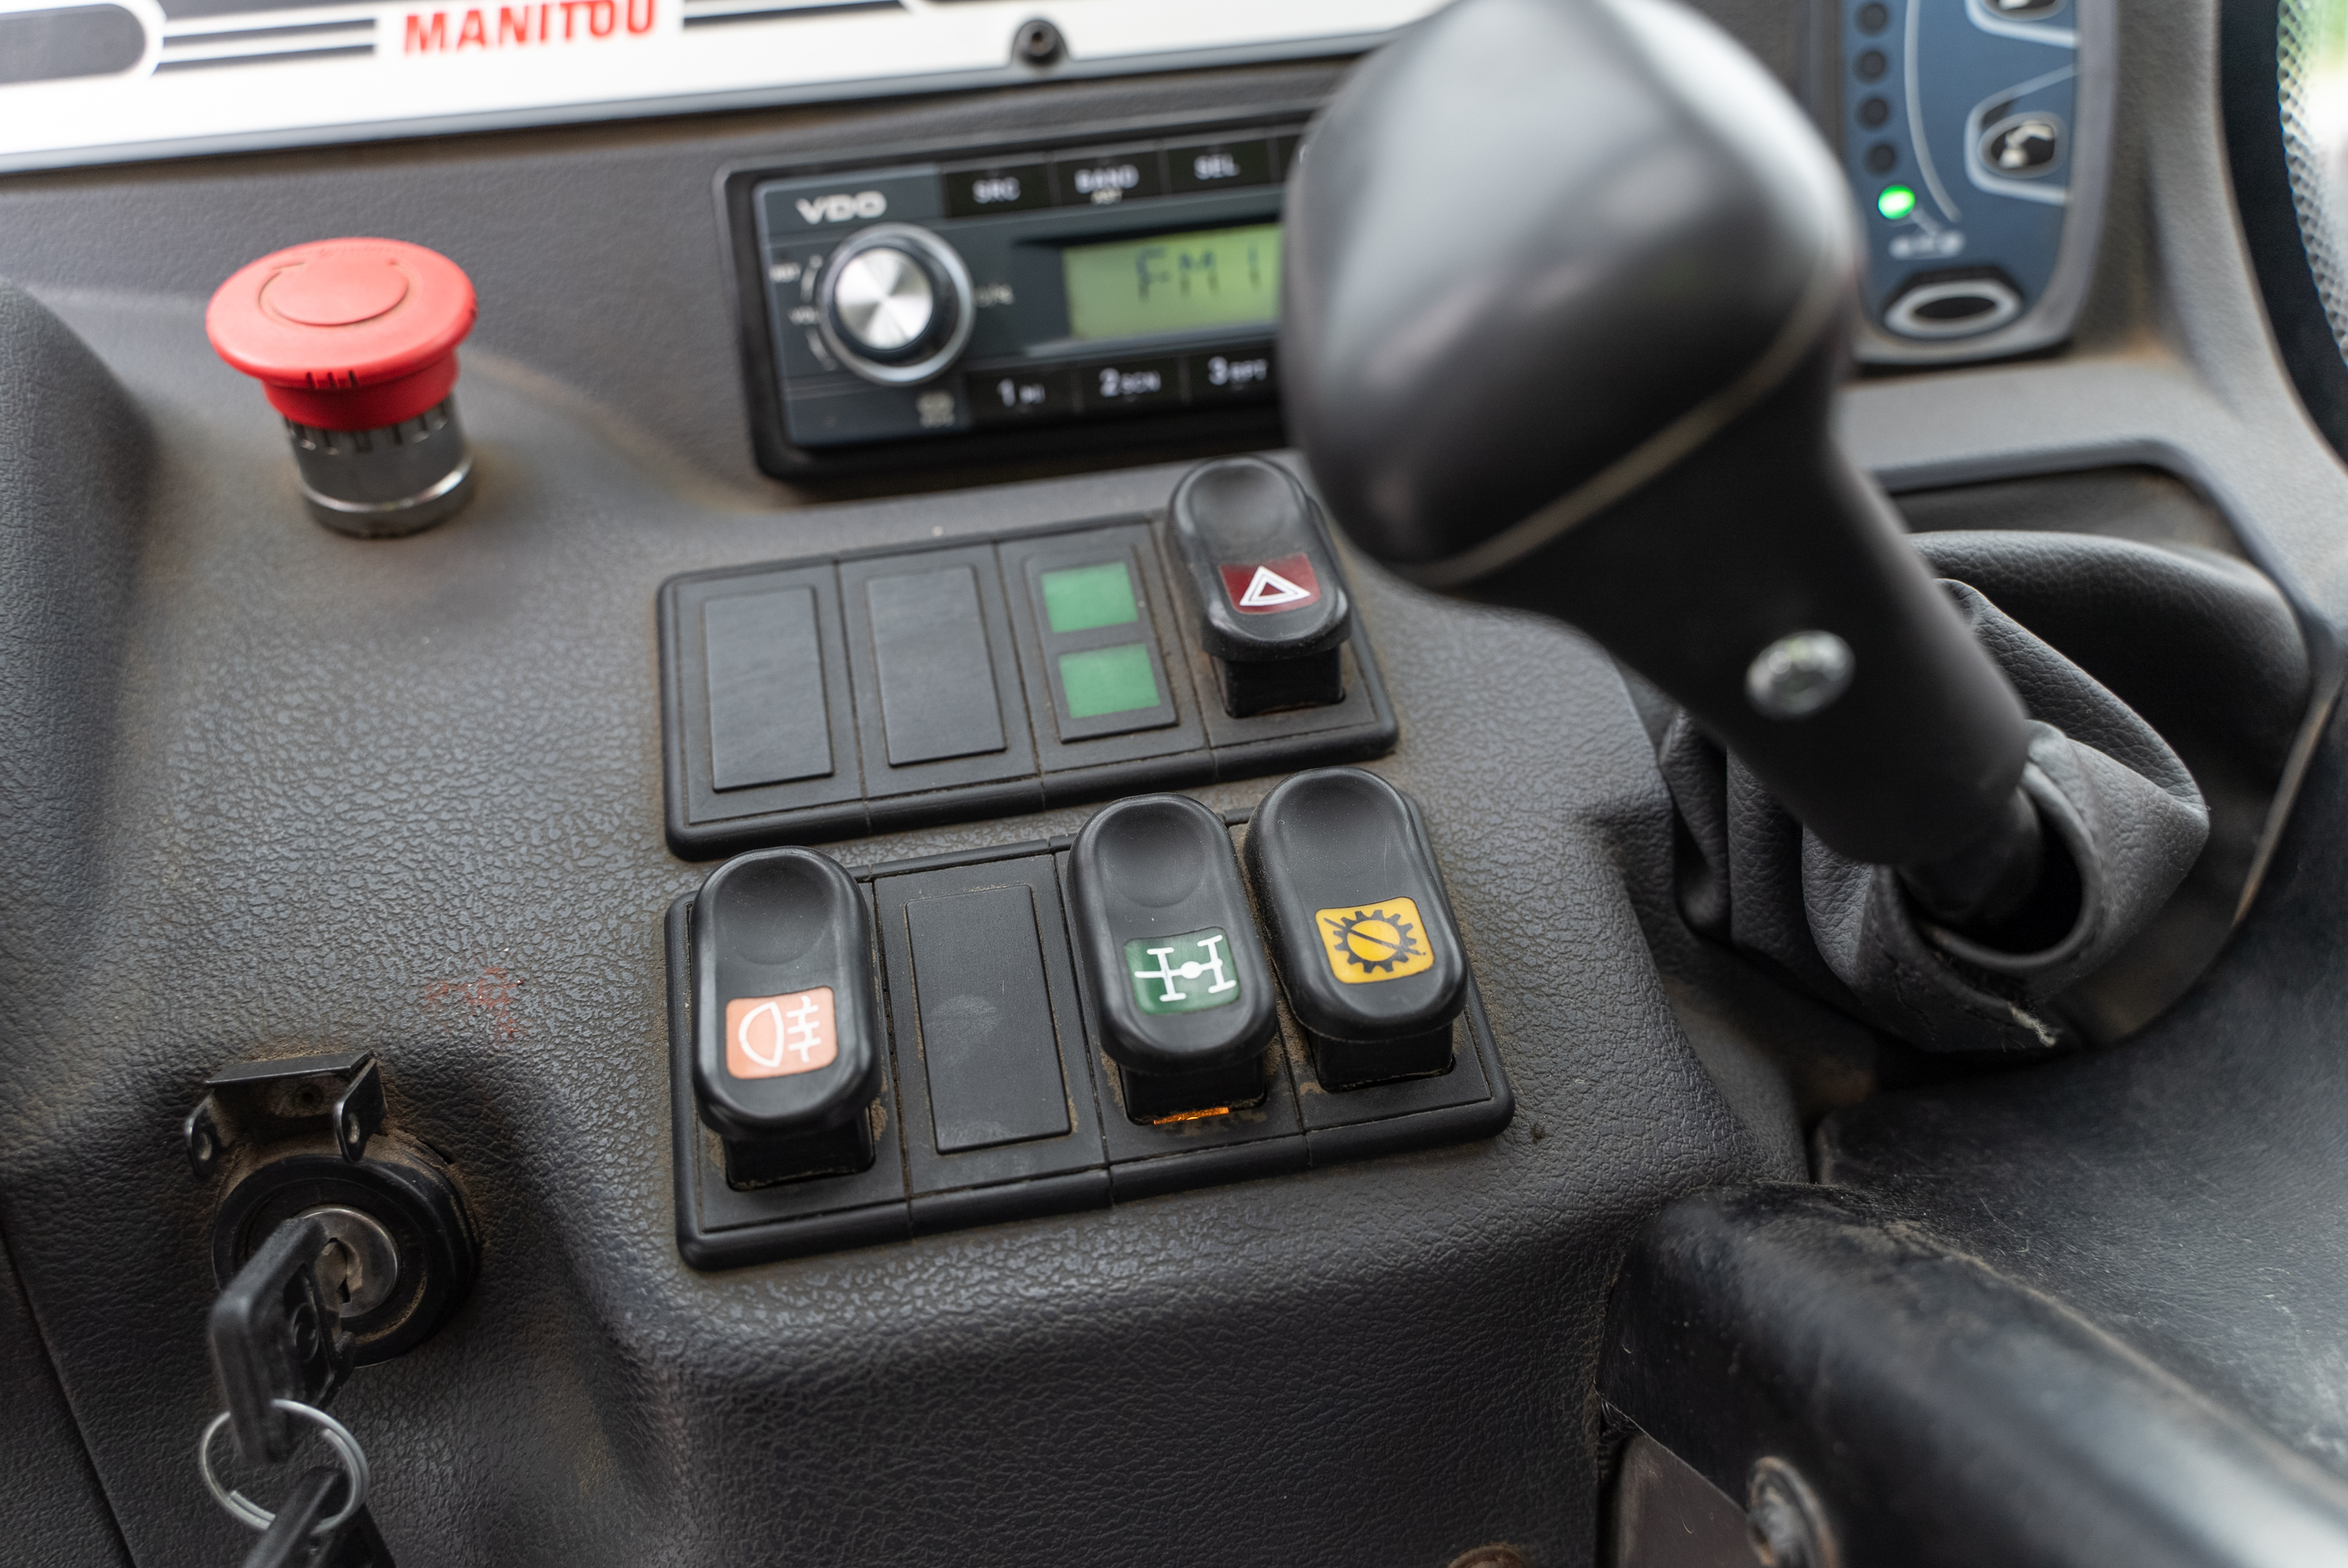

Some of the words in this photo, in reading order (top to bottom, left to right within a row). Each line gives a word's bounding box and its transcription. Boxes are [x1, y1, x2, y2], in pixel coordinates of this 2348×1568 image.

[404, 0, 655, 54] MANITOU
[1074, 164, 1140, 194] BAND
[795, 190, 887, 225] VDO
